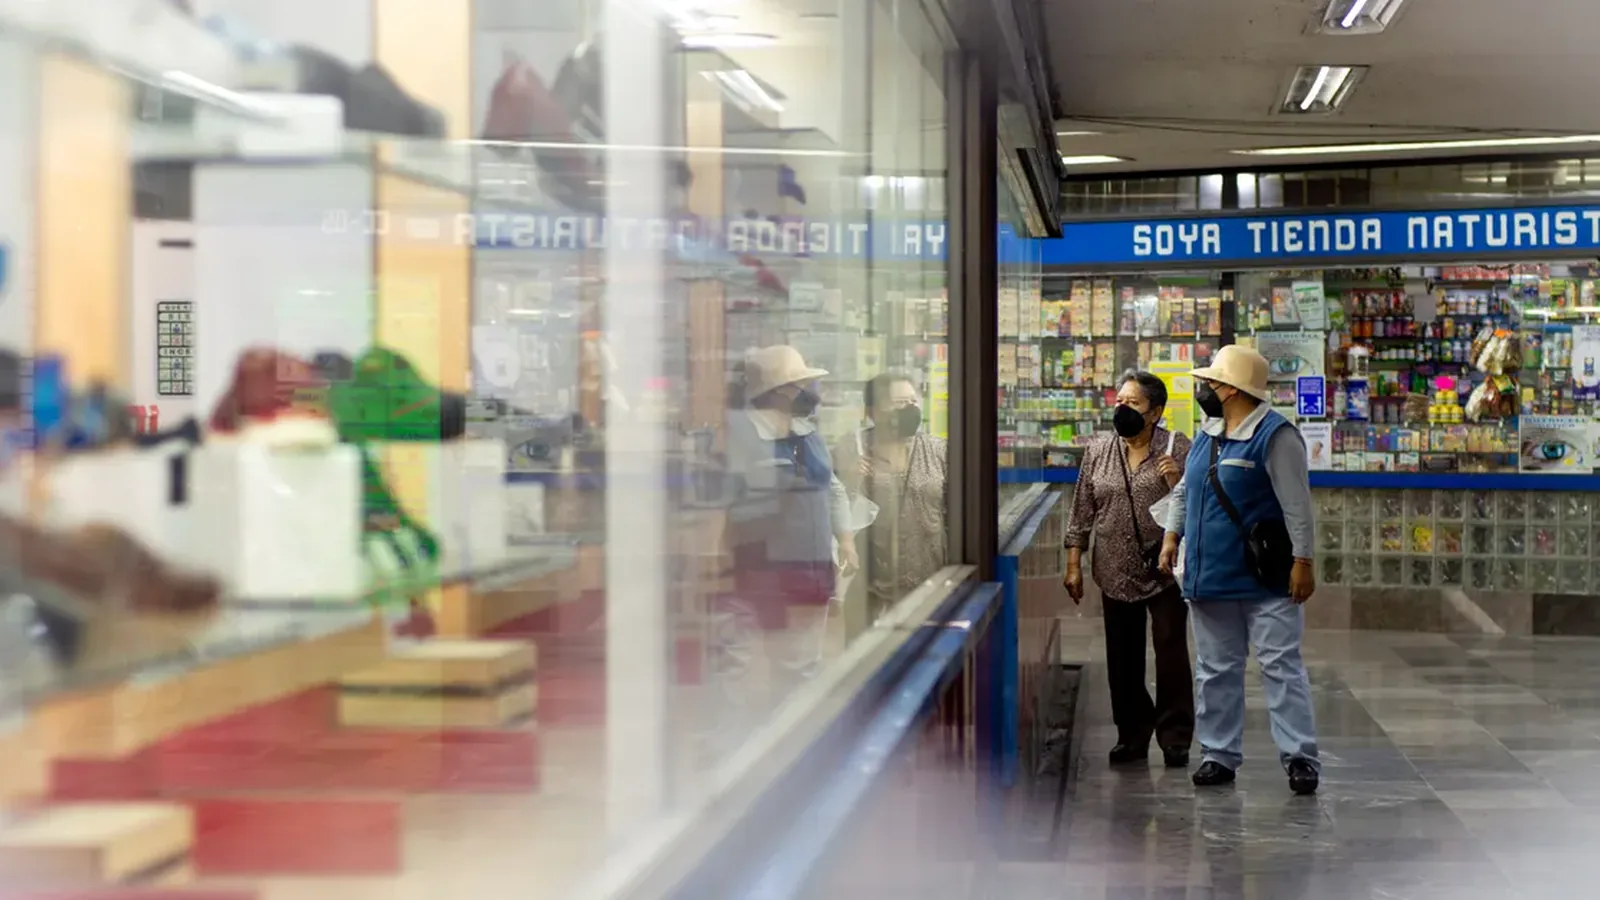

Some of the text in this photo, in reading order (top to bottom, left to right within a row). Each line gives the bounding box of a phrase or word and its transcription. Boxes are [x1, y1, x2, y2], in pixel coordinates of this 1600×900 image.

[1133, 210, 1600, 256] SOYA TIENDA NATURIST
